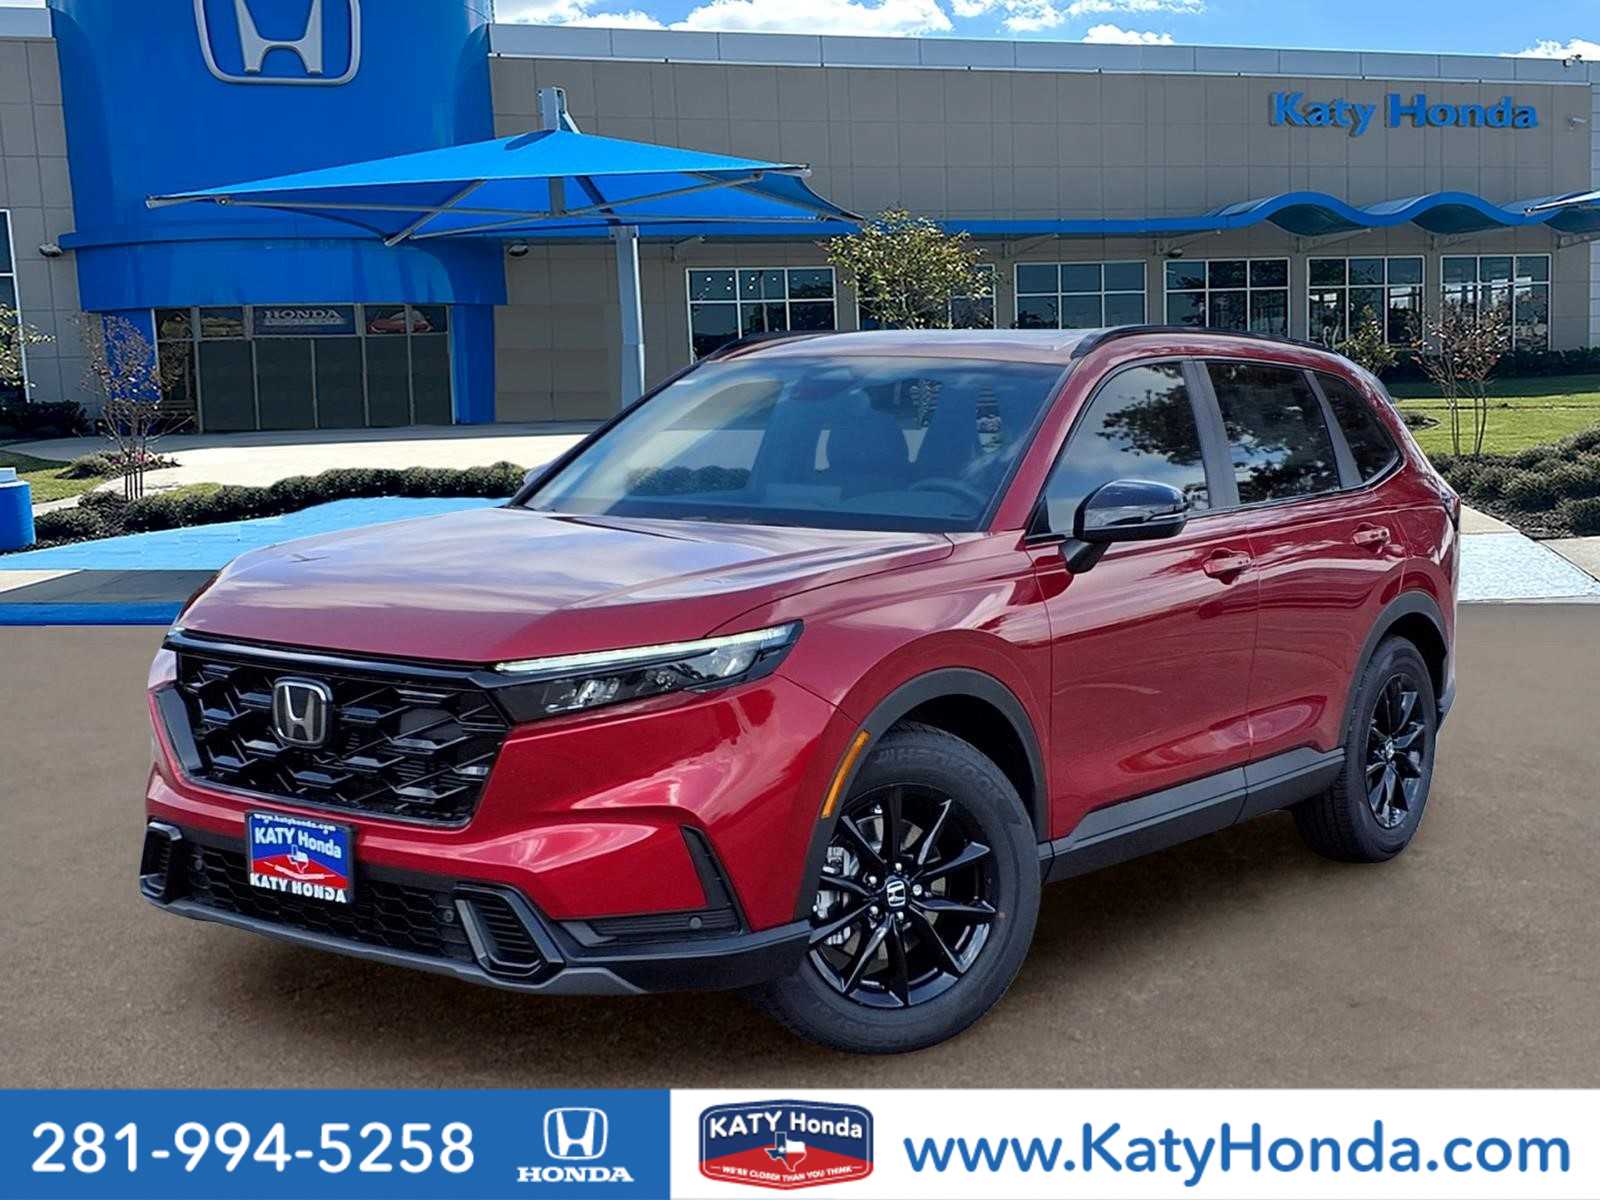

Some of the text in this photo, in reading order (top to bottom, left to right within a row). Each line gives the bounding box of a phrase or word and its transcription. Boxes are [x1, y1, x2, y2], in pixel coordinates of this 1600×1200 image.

[1269, 91, 1539, 137] Katy Honda
[264, 310, 344, 320] HONDA
[254, 827, 342, 859] KATY Honda
[249, 873, 347, 903] KATY HONDA
